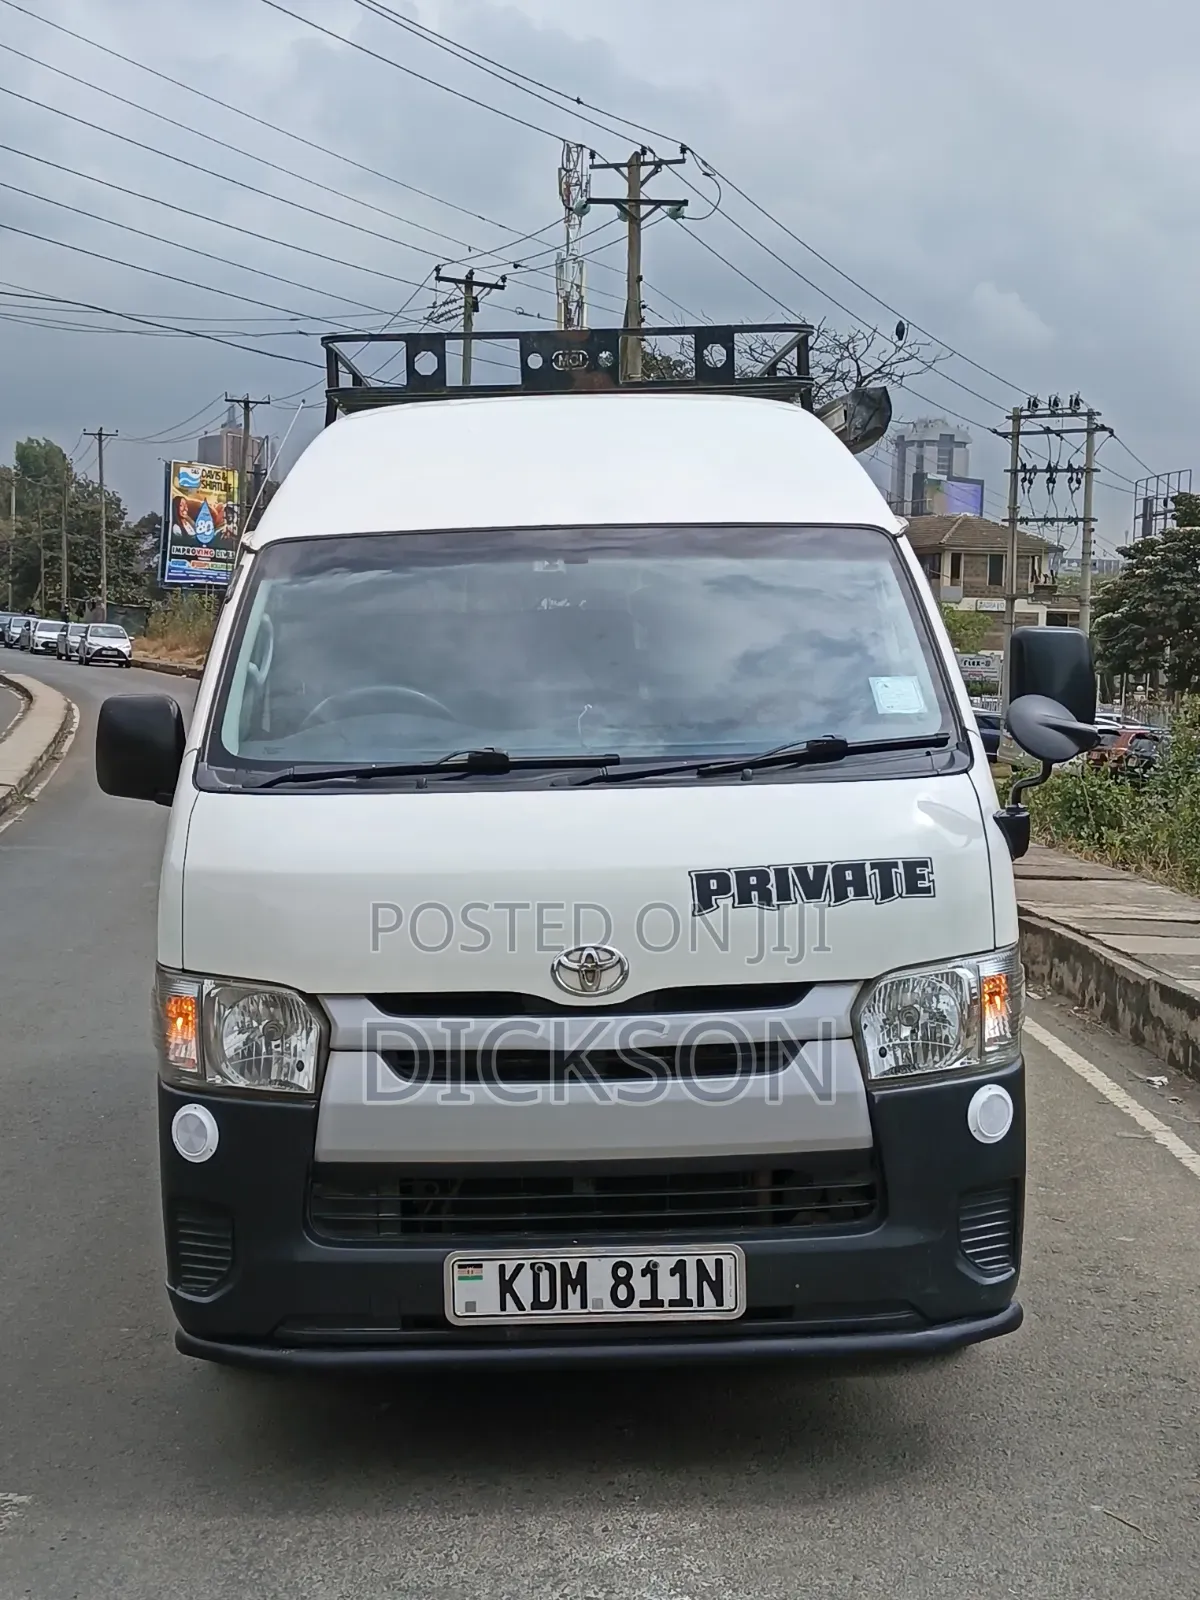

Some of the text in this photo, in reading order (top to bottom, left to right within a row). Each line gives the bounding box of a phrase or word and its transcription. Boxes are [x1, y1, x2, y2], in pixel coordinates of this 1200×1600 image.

[201, 468, 221, 481] DAVIS
[196, 520, 214, 536] 80
[172, 546, 214, 556] IMPROVING
[688, 857, 935, 917] PRIVATE
[498, 1260, 588, 1312] KDM
[609, 1257, 725, 1309] 811N
